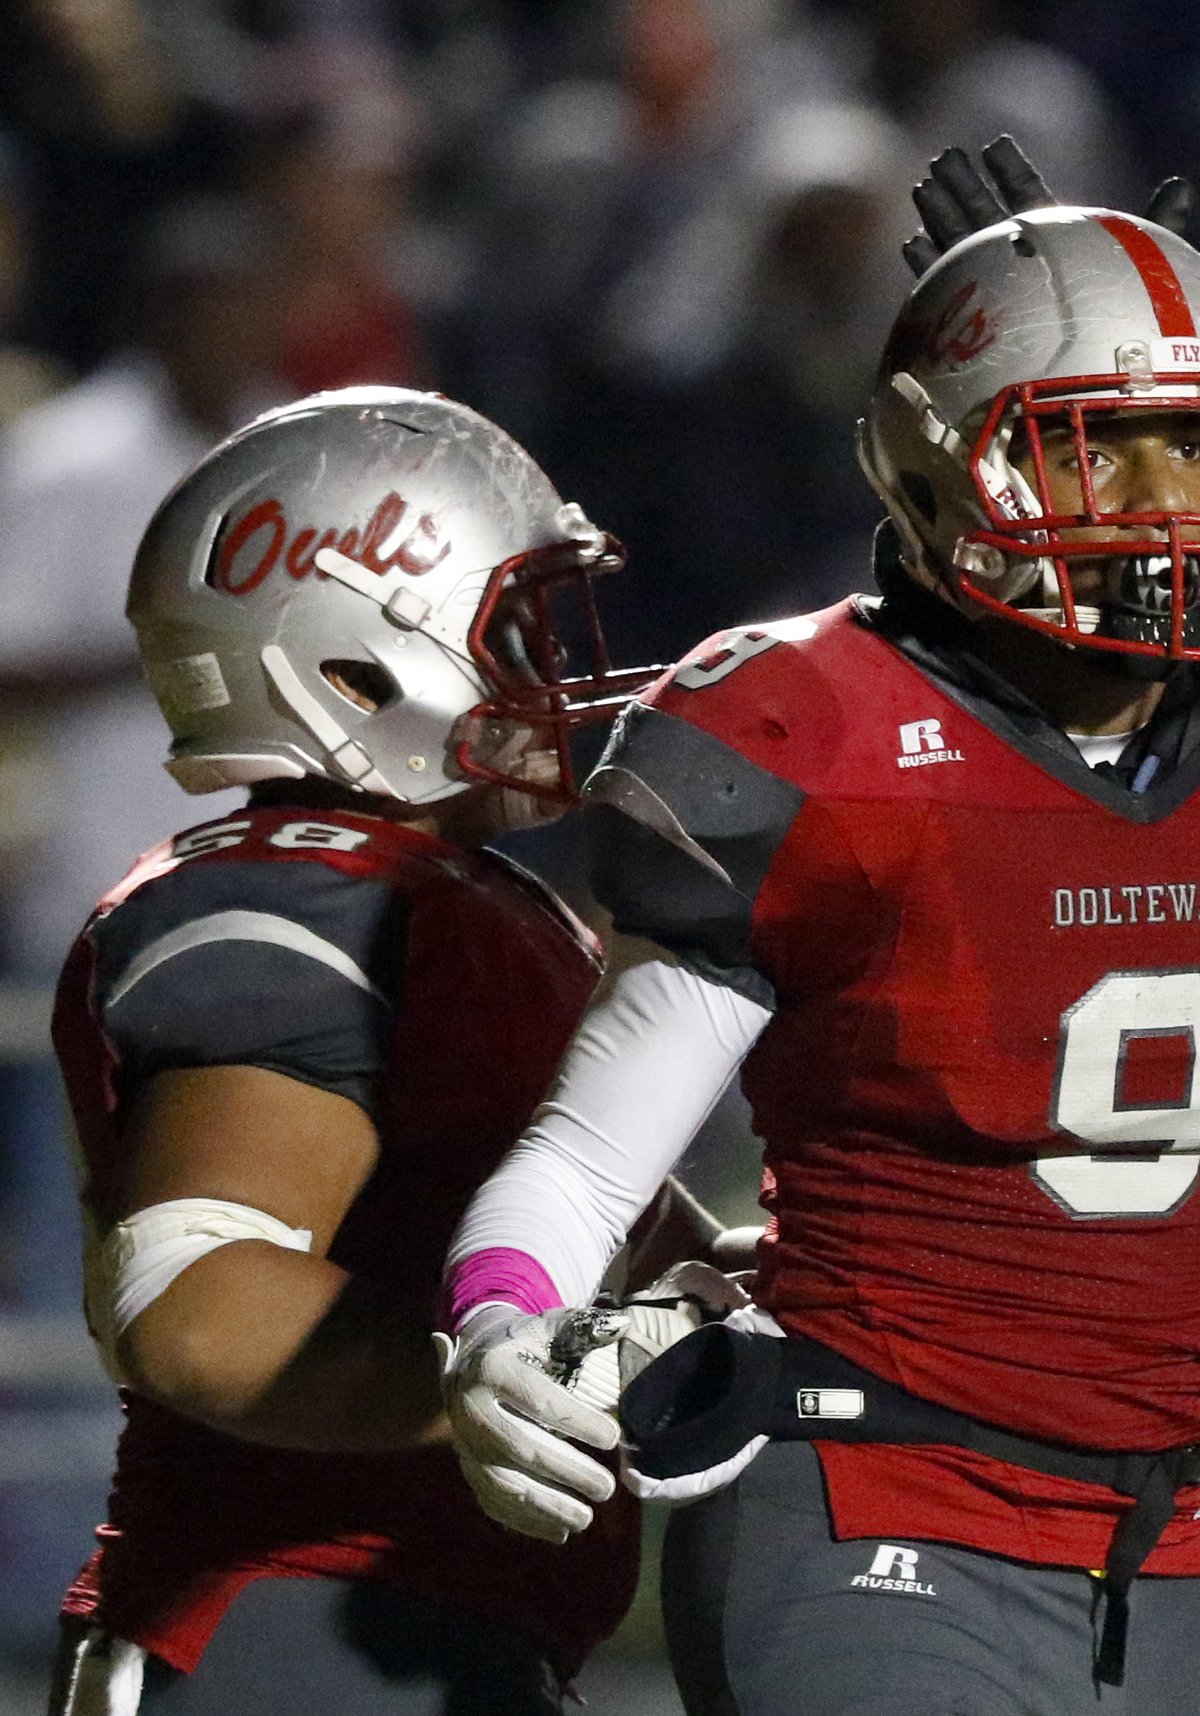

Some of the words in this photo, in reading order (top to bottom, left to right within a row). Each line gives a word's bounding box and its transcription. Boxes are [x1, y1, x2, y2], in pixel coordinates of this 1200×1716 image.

[1171, 344, 1200, 362] FLY
[217, 490, 452, 596] Owls
[899, 718, 945, 755] R
[897, 749, 966, 769] RUSSELL
[155, 819, 371, 869] 58
[868, 1544, 919, 1581] R
[850, 1574, 937, 1597] RUSSELL
